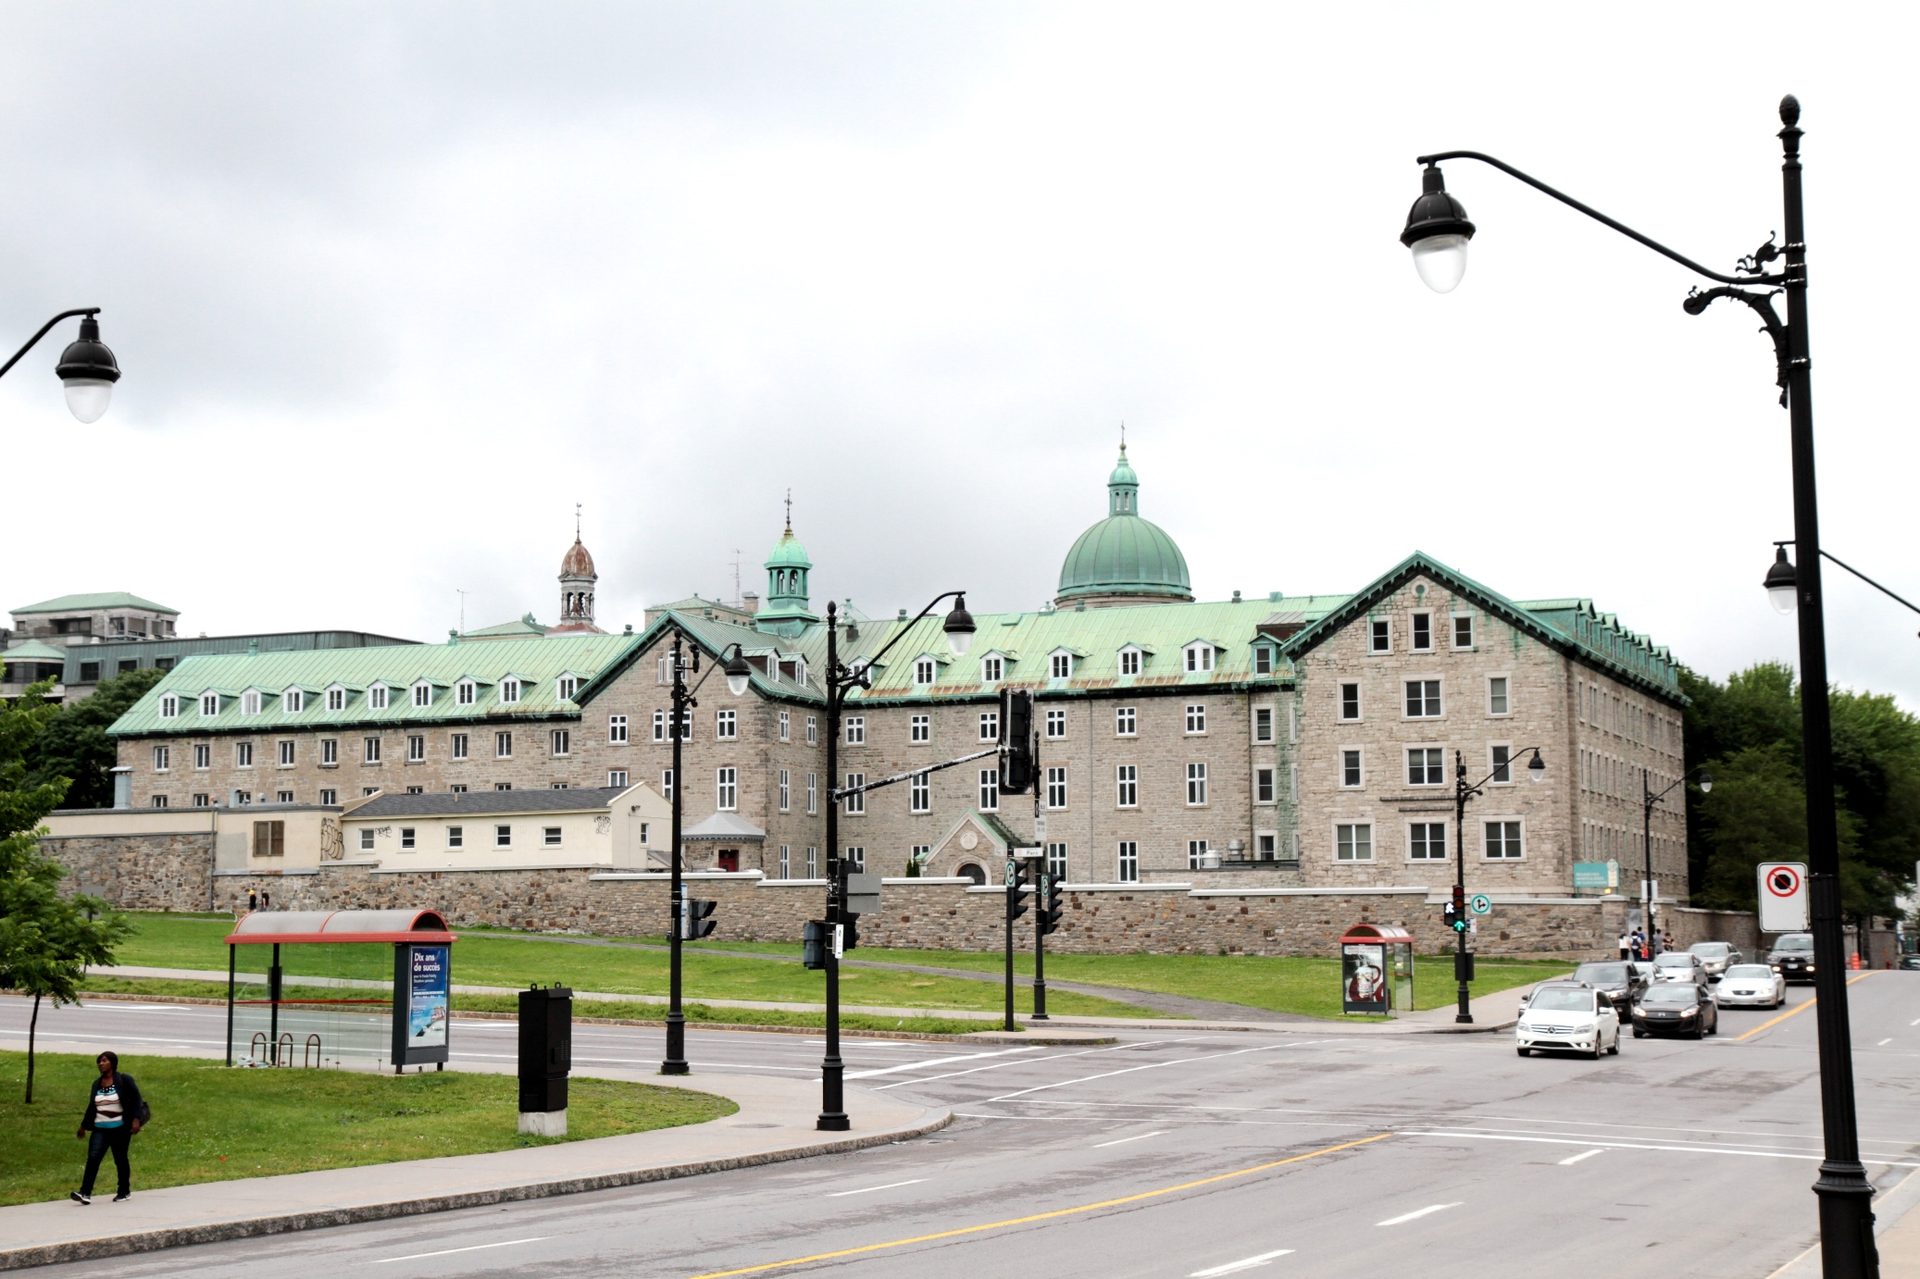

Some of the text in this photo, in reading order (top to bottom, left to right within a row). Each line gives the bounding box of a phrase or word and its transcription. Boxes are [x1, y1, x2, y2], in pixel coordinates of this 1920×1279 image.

[414, 952, 424, 961] Dix
[414, 962, 440, 971] de succès
